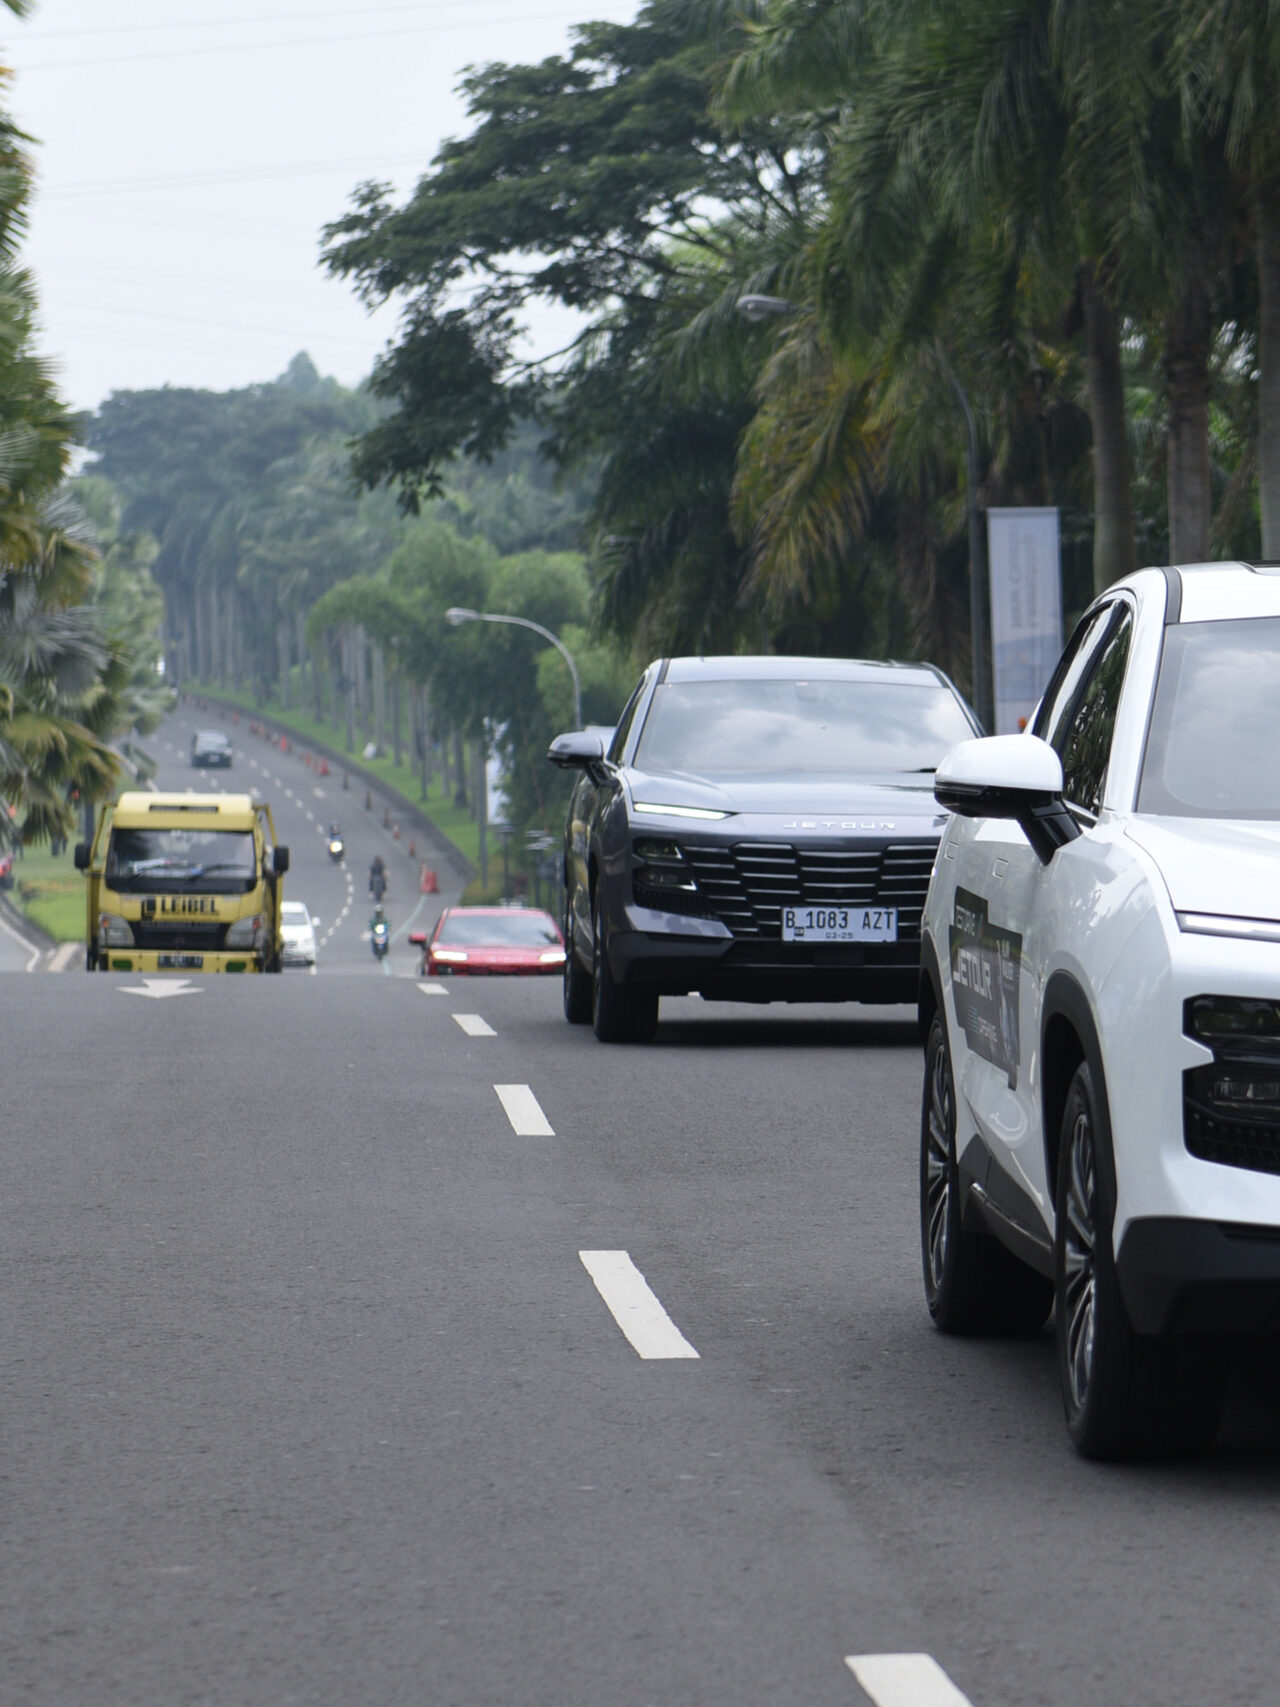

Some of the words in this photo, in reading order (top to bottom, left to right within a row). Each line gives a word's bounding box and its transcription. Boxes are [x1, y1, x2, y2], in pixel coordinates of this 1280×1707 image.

[783, 821, 896, 830] JETOUR
[785, 910, 796, 929] B
[805, 910, 849, 929] 1083
[861, 911, 894, 930] AZT
[953, 946, 993, 1001] JETOUR
